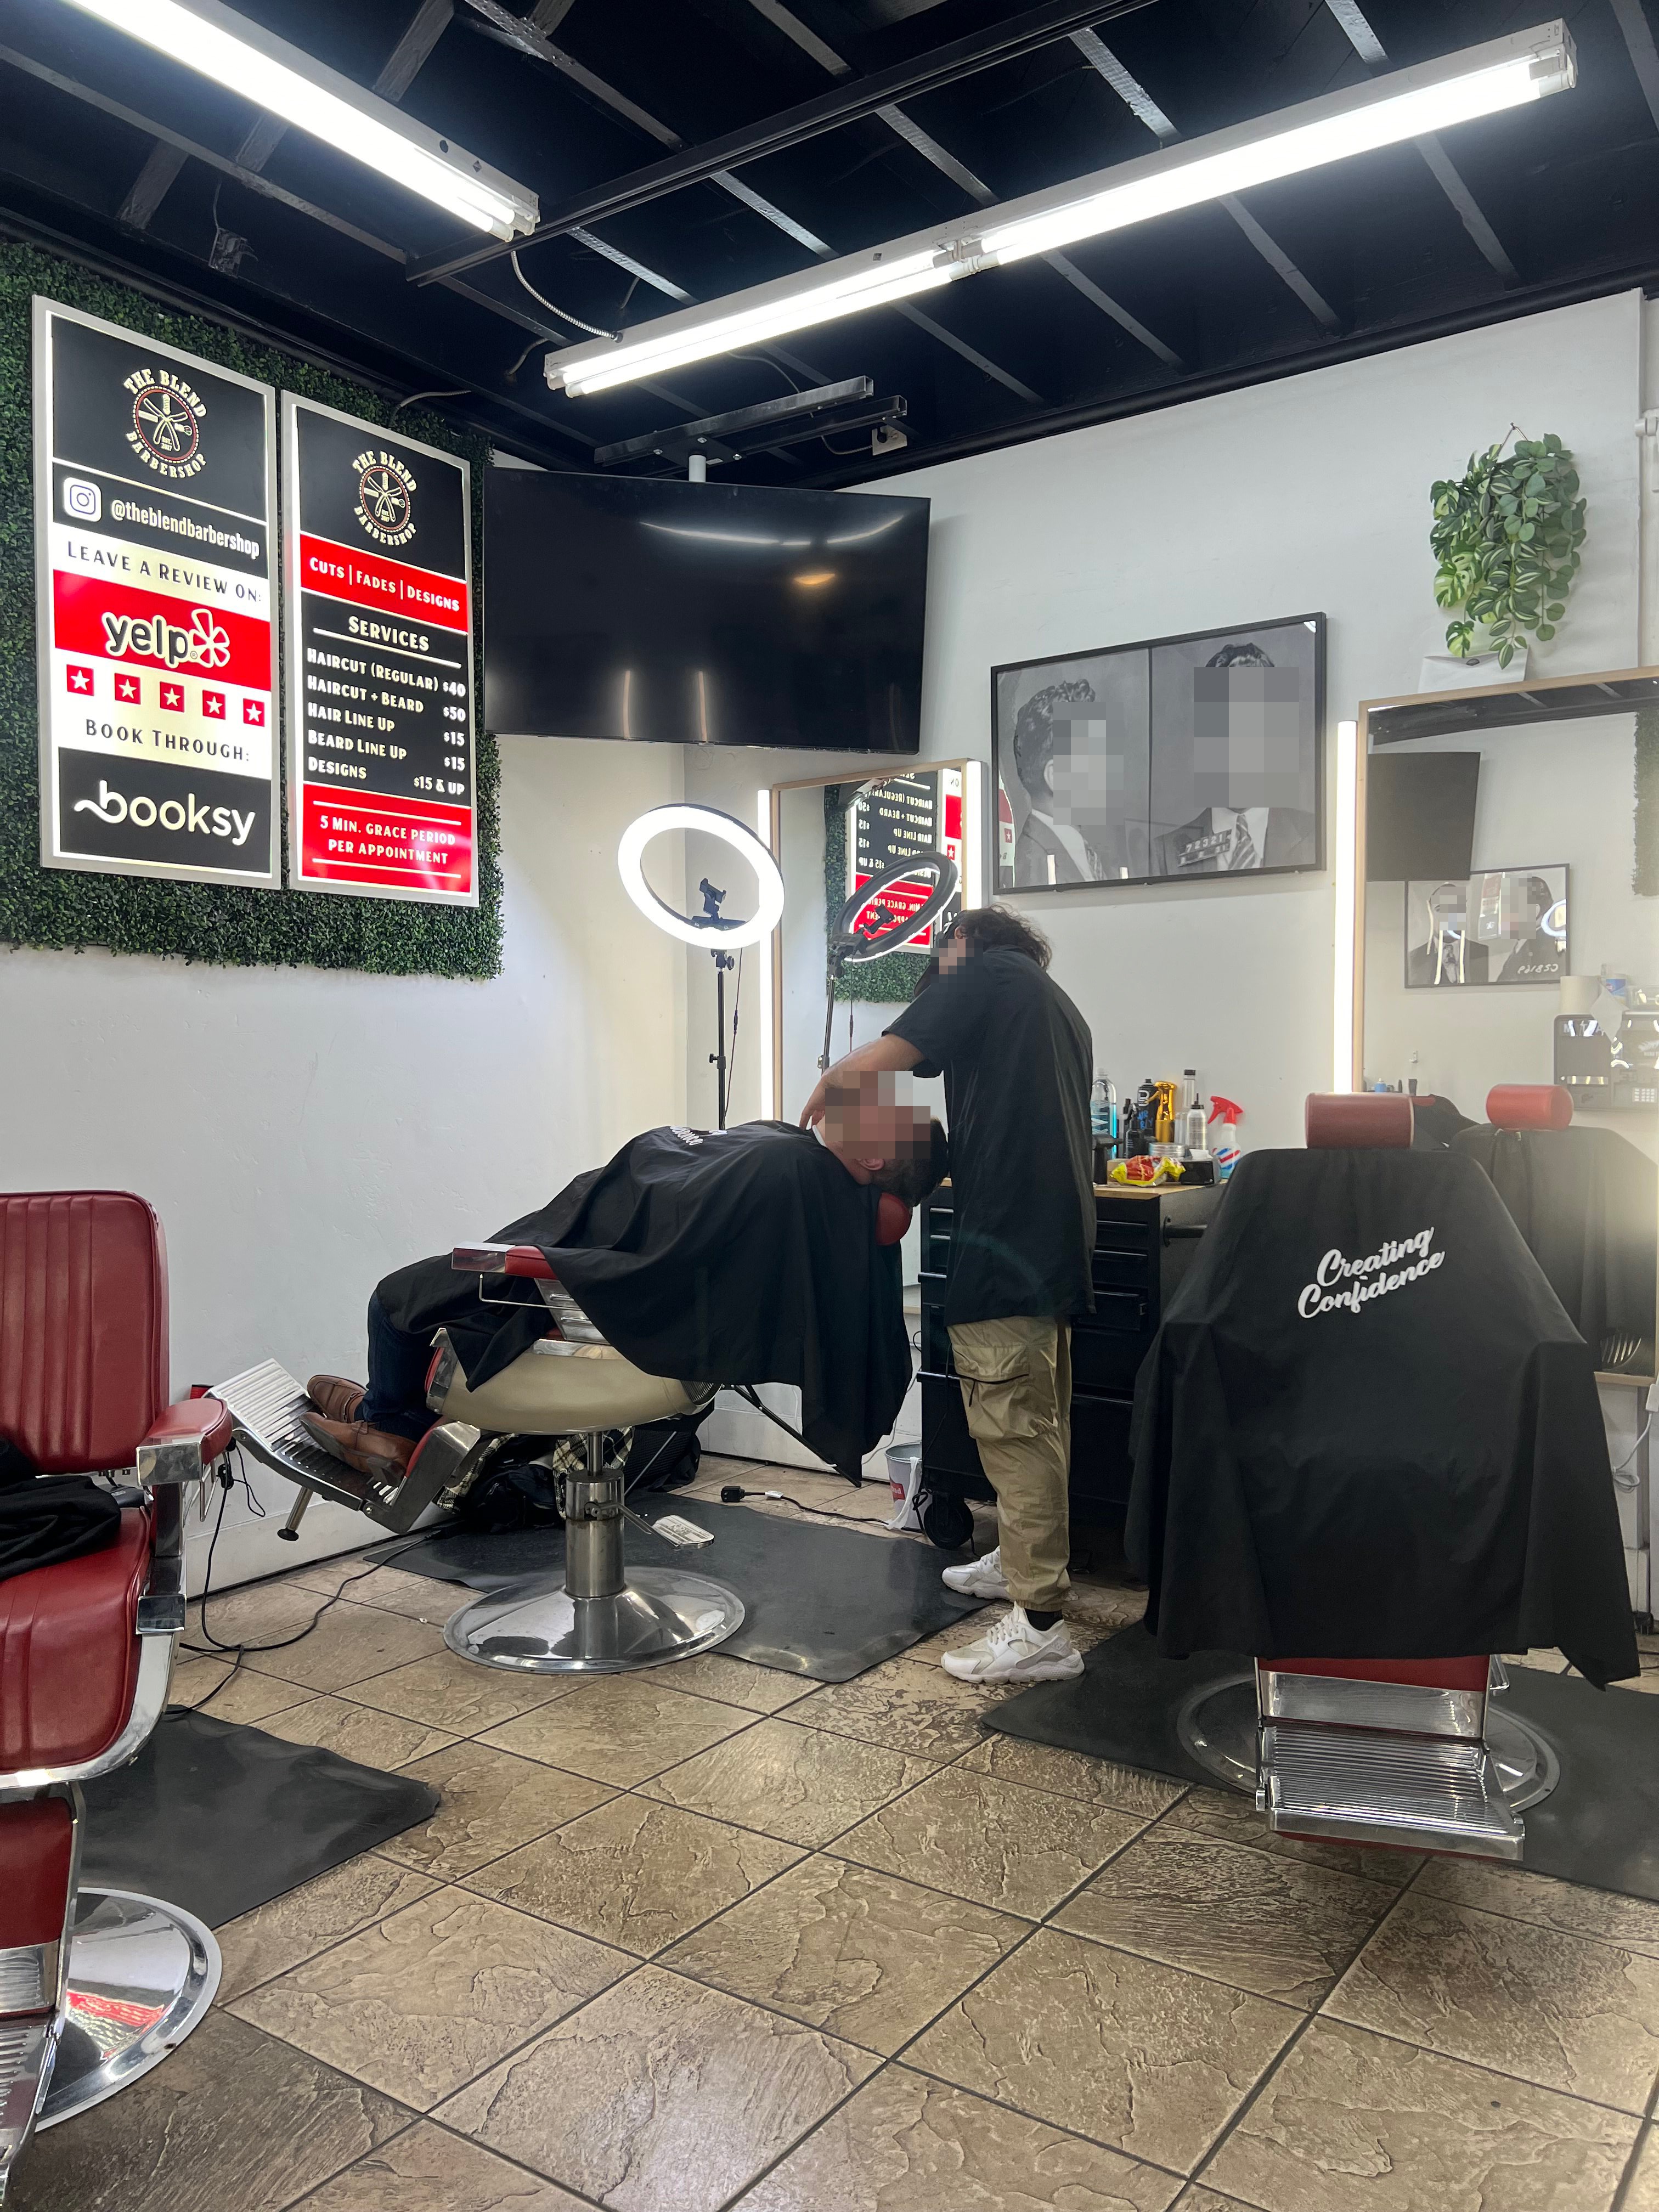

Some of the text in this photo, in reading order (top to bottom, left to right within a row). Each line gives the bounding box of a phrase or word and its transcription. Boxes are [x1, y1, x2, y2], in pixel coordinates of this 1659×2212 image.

[123, 369, 207, 418] THE BLEND
[126, 431, 207, 478] BARBERSHOP
[352, 450, 417, 492] THE BLEND
[111, 499, 260, 560] @theblendbarbershop
[354, 506, 417, 546] BARBERSHOP
[67, 540, 262, 602] LEAVE A REVIEW ON:
[309, 557, 460, 612] CUTS FADES DESIGNS
[103, 613, 189, 668] yelp
[348, 616, 430, 652] SERVICES
[307, 647, 466, 697] HAIRCUT (REGULAR) $40
[307, 674, 367, 702] HAIRCUT
[381, 691, 424, 713] BEARD
[443, 707, 466, 723] $50
[86, 719, 250, 761] BOOK THROUGH:
[307, 702, 465, 747] HAIR LINE UP $15
[308, 729, 465, 771] BEARD LINE UP $15
[308, 756, 367, 780] DESIGNS
[414, 776, 433, 791] $15
[448, 782, 465, 795] UP
[74, 780, 256, 846] booksy
[320, 815, 456, 845] 5 MIN. GRACE PERIOD
[329, 839, 448, 865] PER APPOINTMENT
[1316, 1226, 1435, 1287] Creating
[1297, 1251, 1446, 1318] Confidence
